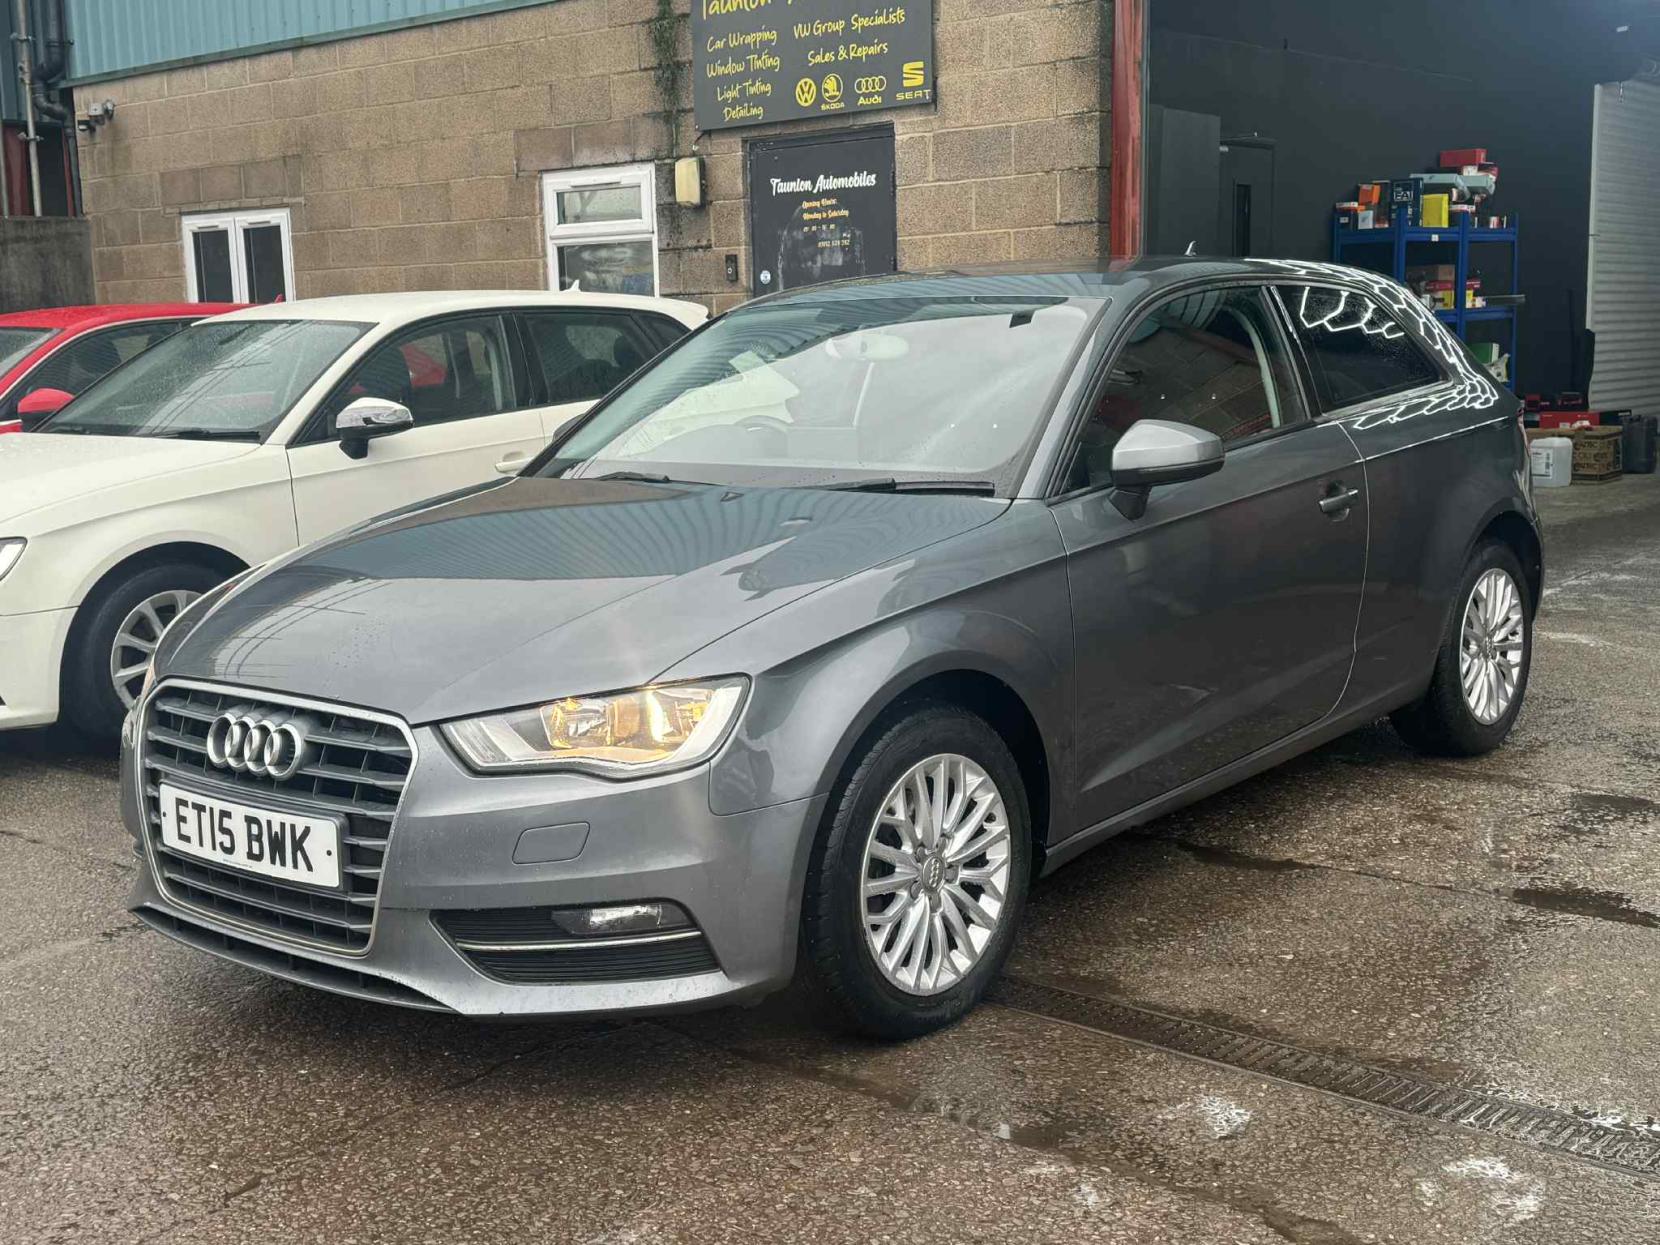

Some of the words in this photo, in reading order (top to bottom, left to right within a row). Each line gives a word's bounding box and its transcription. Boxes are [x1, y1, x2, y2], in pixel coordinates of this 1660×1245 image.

[813, 20, 845, 37] Group
[851, 7, 906, 33] Specialists
[706, 36, 726, 52] Car
[728, 25, 777, 49] Wrapping
[706, 56, 745, 78] Window
[746, 49, 780, 72] Tinting
[807, 48, 835, 66] Sales
[838, 45, 848, 61] &
[849, 39, 888, 62] Repairs
[717, 83, 742, 103] Light
[742, 78, 772, 97] Tinting
[857, 95, 882, 106] Audi
[896, 89, 931, 101] SEAT
[723, 102, 764, 122] Detailing
[769, 178, 813, 197] Taunton
[812, 171, 877, 194] Automobiles
[174, 797, 236, 855] ET15
[243, 814, 314, 872] BWK
